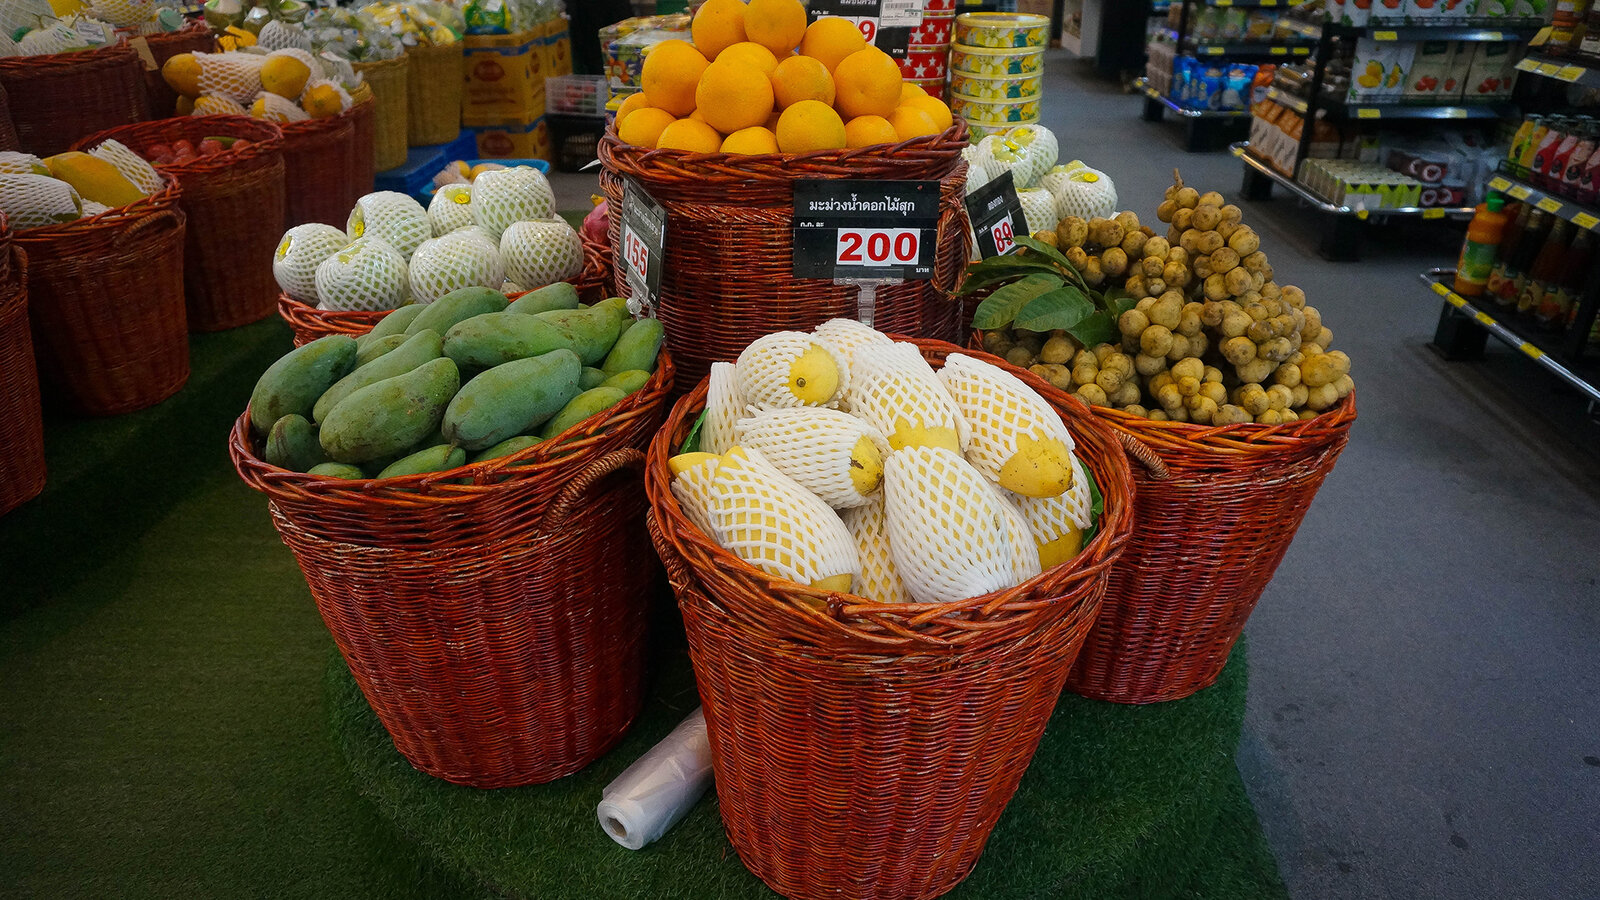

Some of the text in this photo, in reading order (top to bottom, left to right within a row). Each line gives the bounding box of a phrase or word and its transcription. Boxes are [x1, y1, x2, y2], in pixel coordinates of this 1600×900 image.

[809, 193, 915, 216] มะม่วงน้ำดอกไม้สุก
[626, 232, 647, 277] 155
[838, 232, 918, 262] 200
